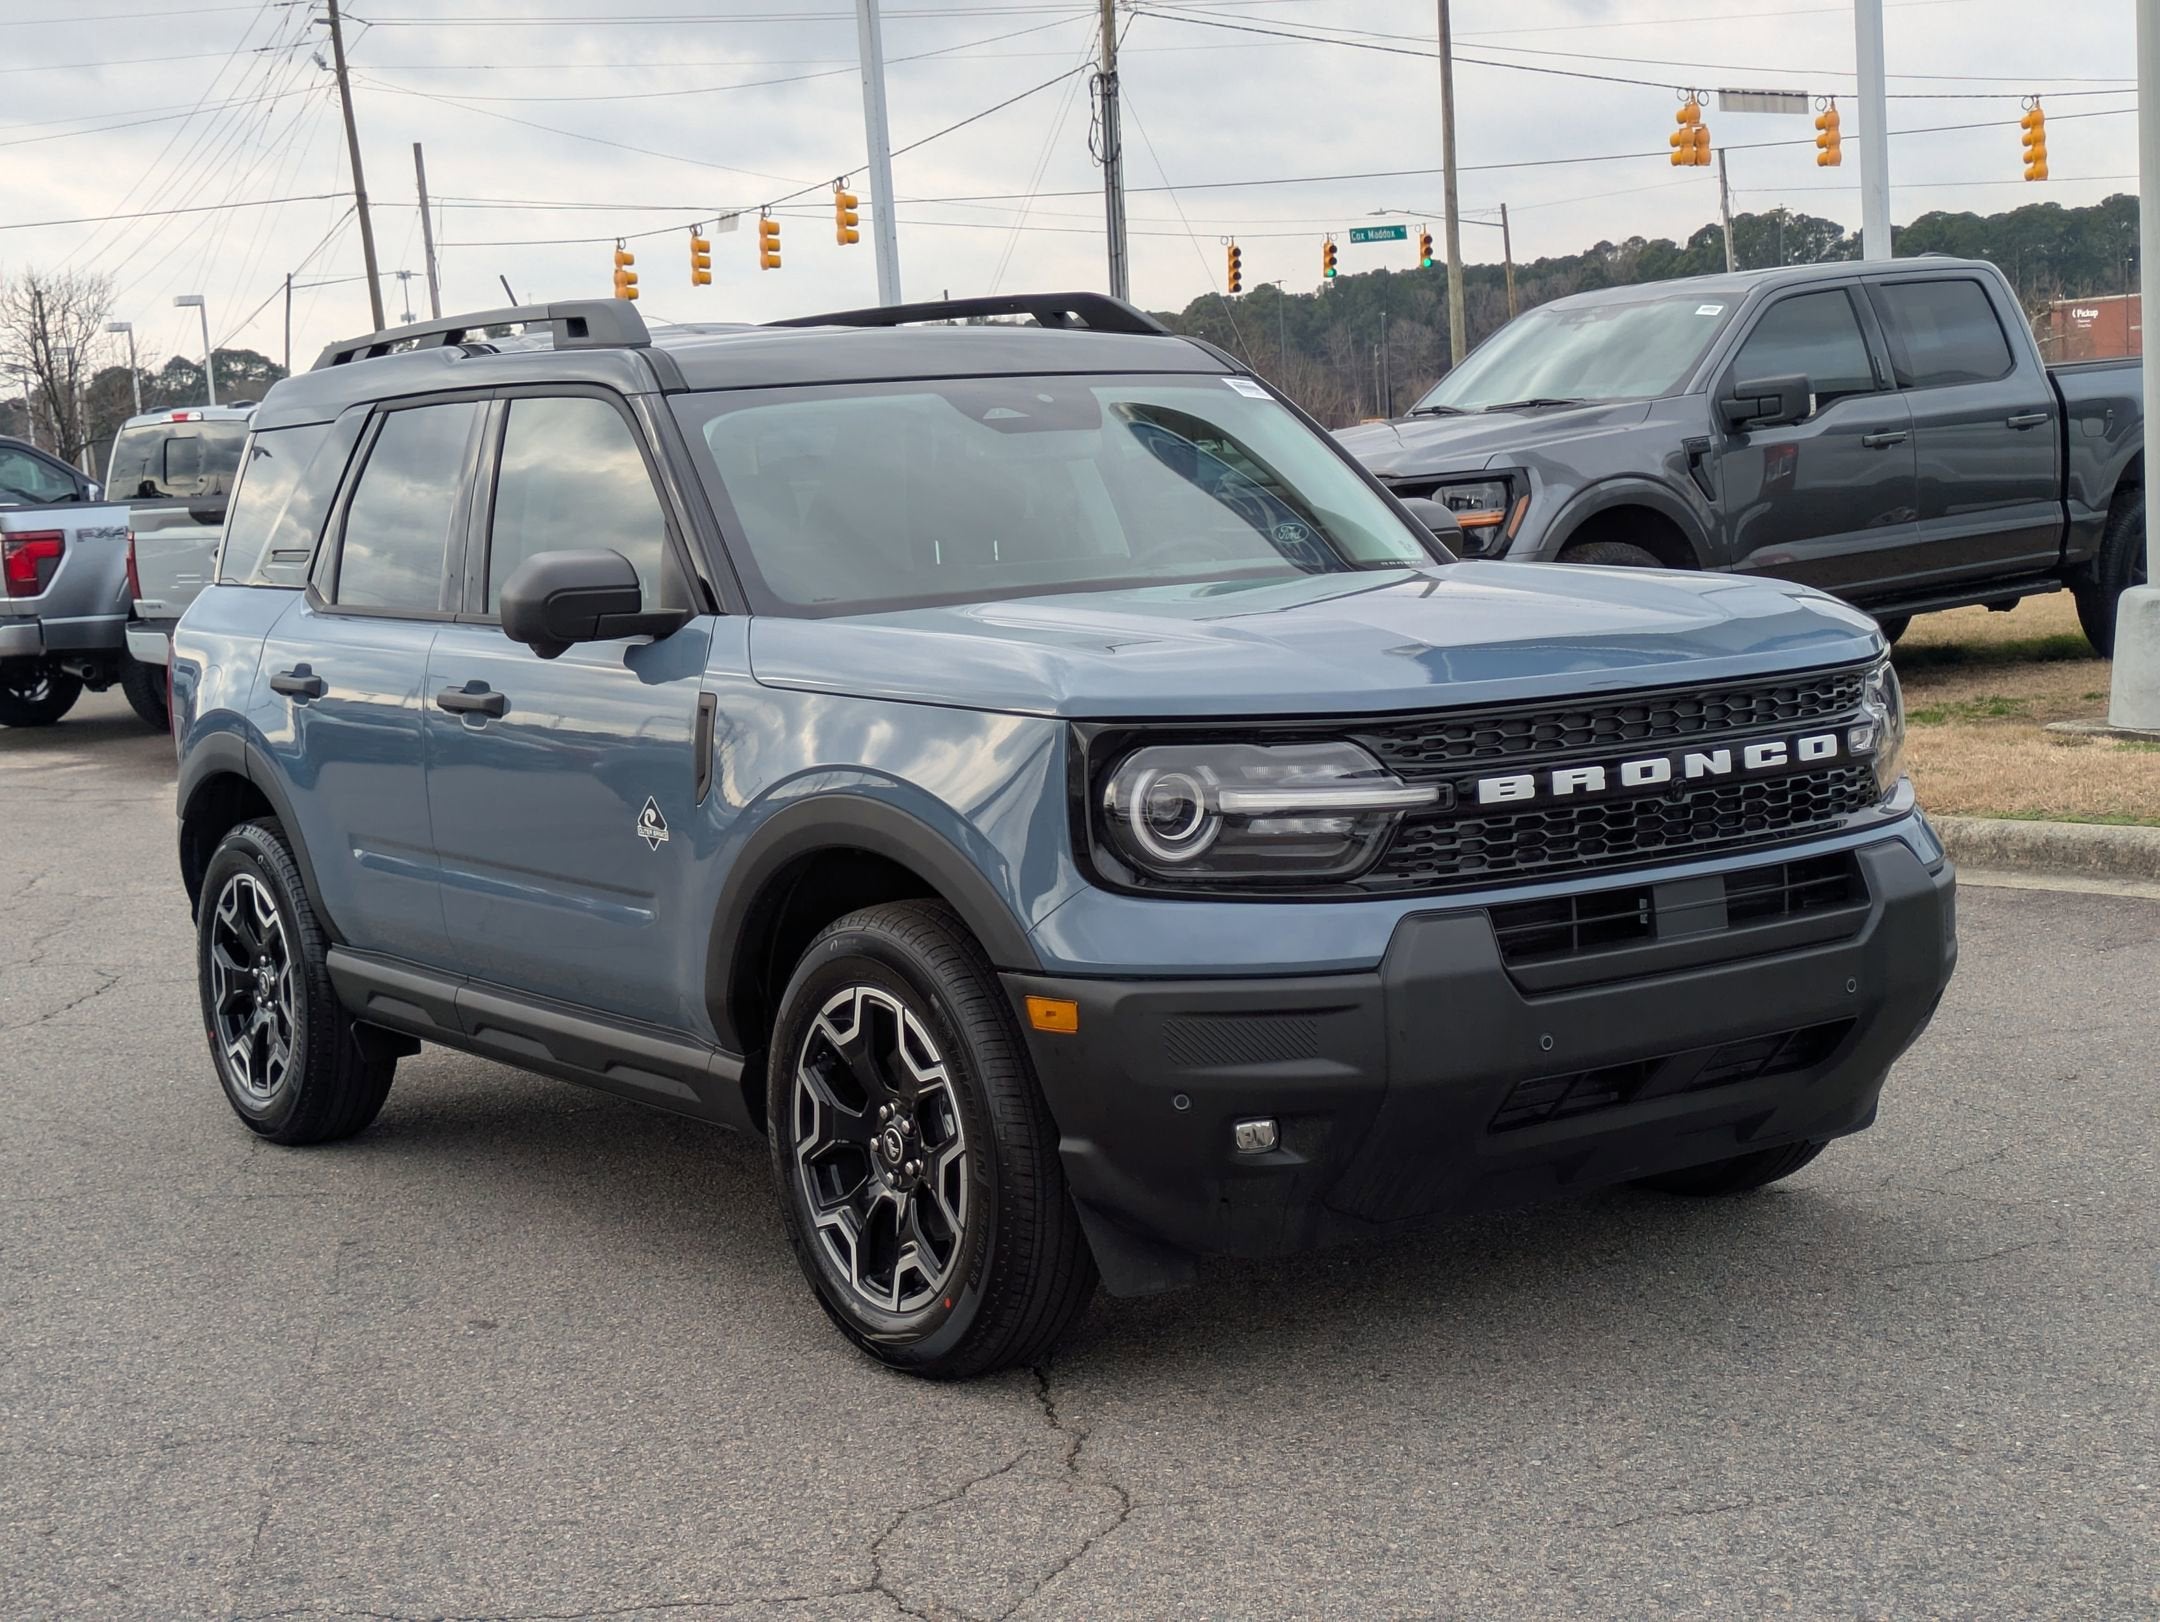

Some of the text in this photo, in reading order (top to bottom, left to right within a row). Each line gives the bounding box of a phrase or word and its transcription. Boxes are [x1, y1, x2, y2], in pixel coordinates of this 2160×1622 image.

[1351, 231, 1365, 241] Cox
[1367, 229, 1396, 241] Maddox
[2077, 309, 2098, 319] Pickup
[76, 526, 128, 543] FX4
[1279, 525, 1302, 540] Ford
[1478, 734, 1838, 804] BRONCO
